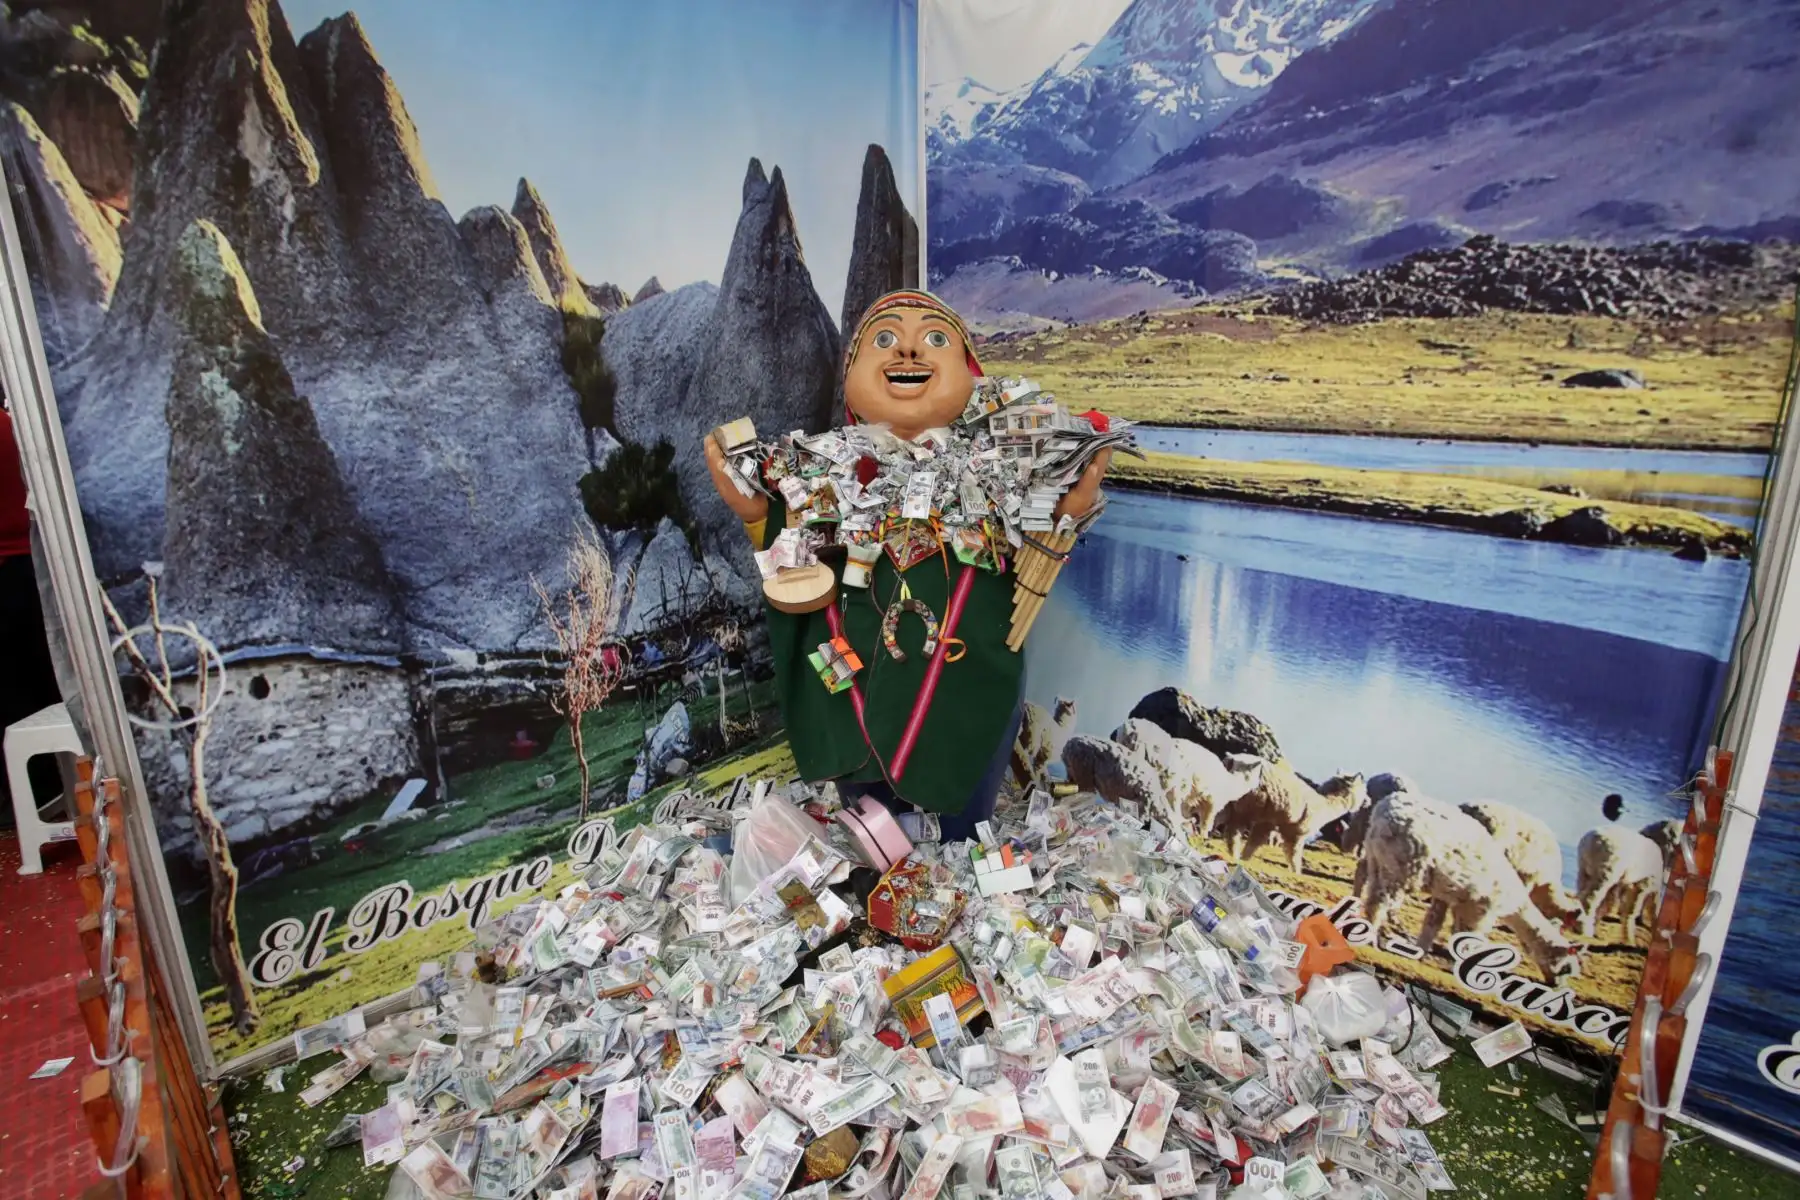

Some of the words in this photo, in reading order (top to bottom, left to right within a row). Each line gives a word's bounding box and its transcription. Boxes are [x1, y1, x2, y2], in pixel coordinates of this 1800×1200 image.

[251, 911, 330, 983] El
[347, 859, 549, 950] Bosque
[669, 1079, 693, 1097] 100
[814, 1109, 831, 1130] 100
[1250, 1161, 1277, 1180] 100
